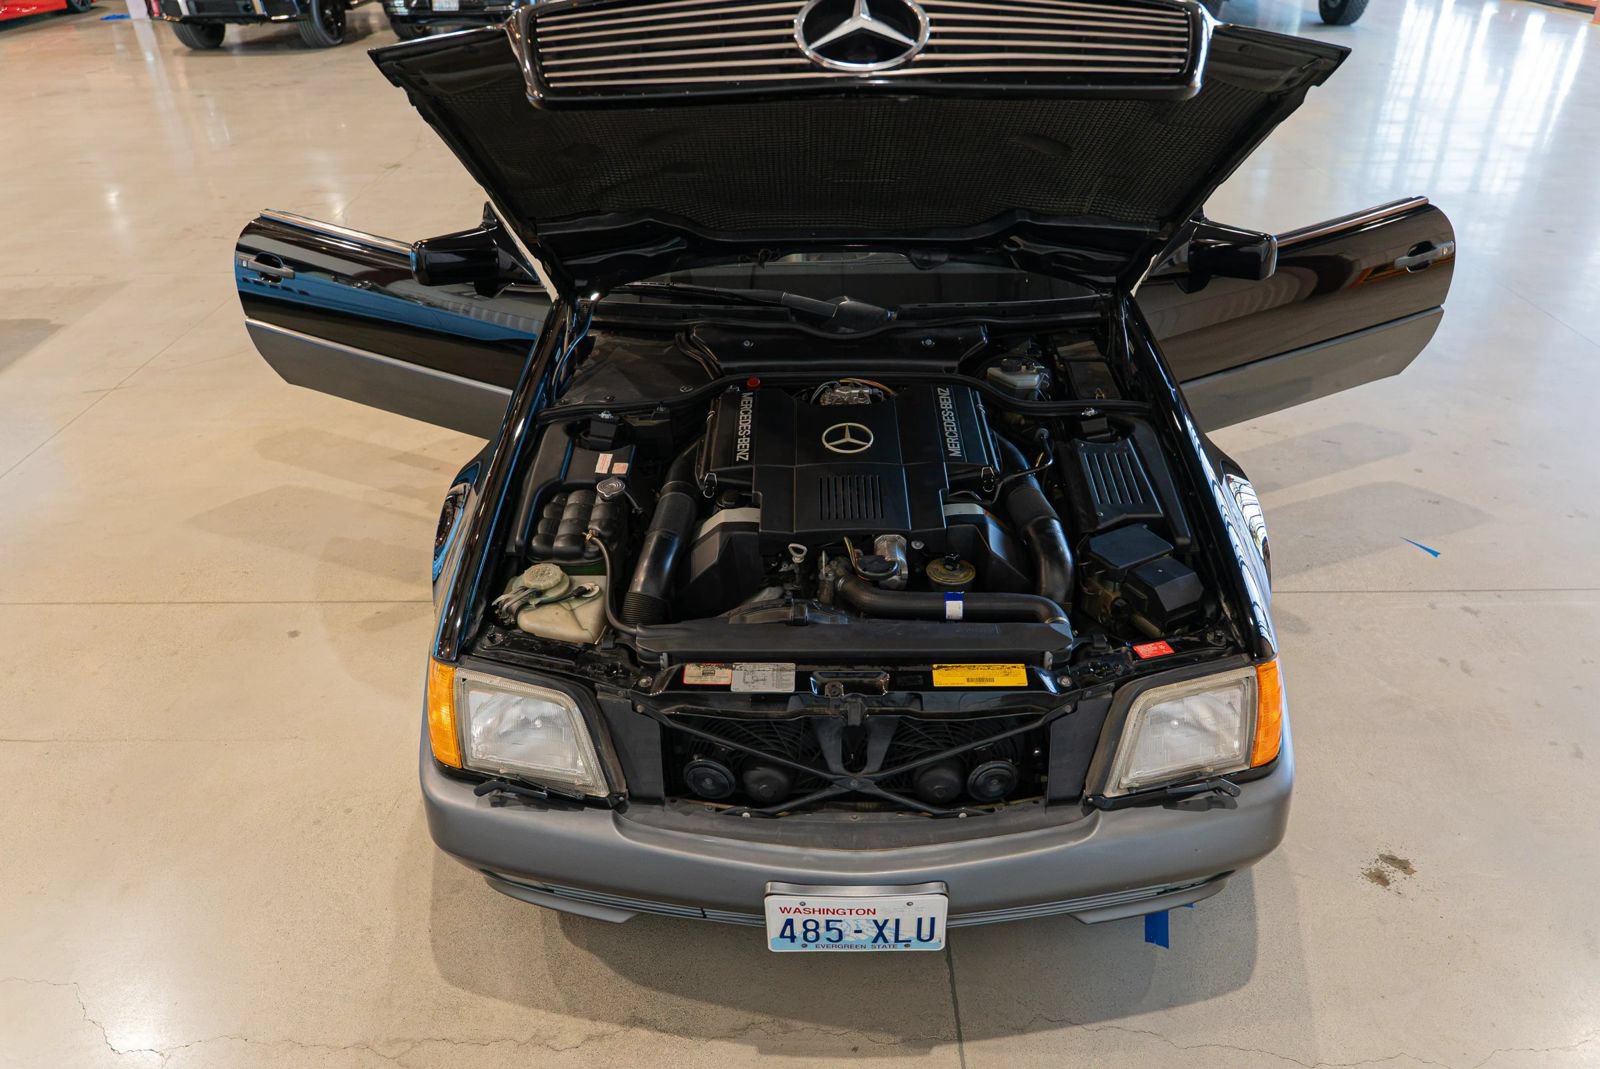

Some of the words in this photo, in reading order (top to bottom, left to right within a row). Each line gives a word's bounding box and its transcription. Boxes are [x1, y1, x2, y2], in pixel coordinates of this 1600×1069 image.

[735, 392, 754, 462] MERCEDES-BENZ
[937, 387, 962, 457] MERCEDES-BENZ
[779, 906, 877, 916] WASHINGTON
